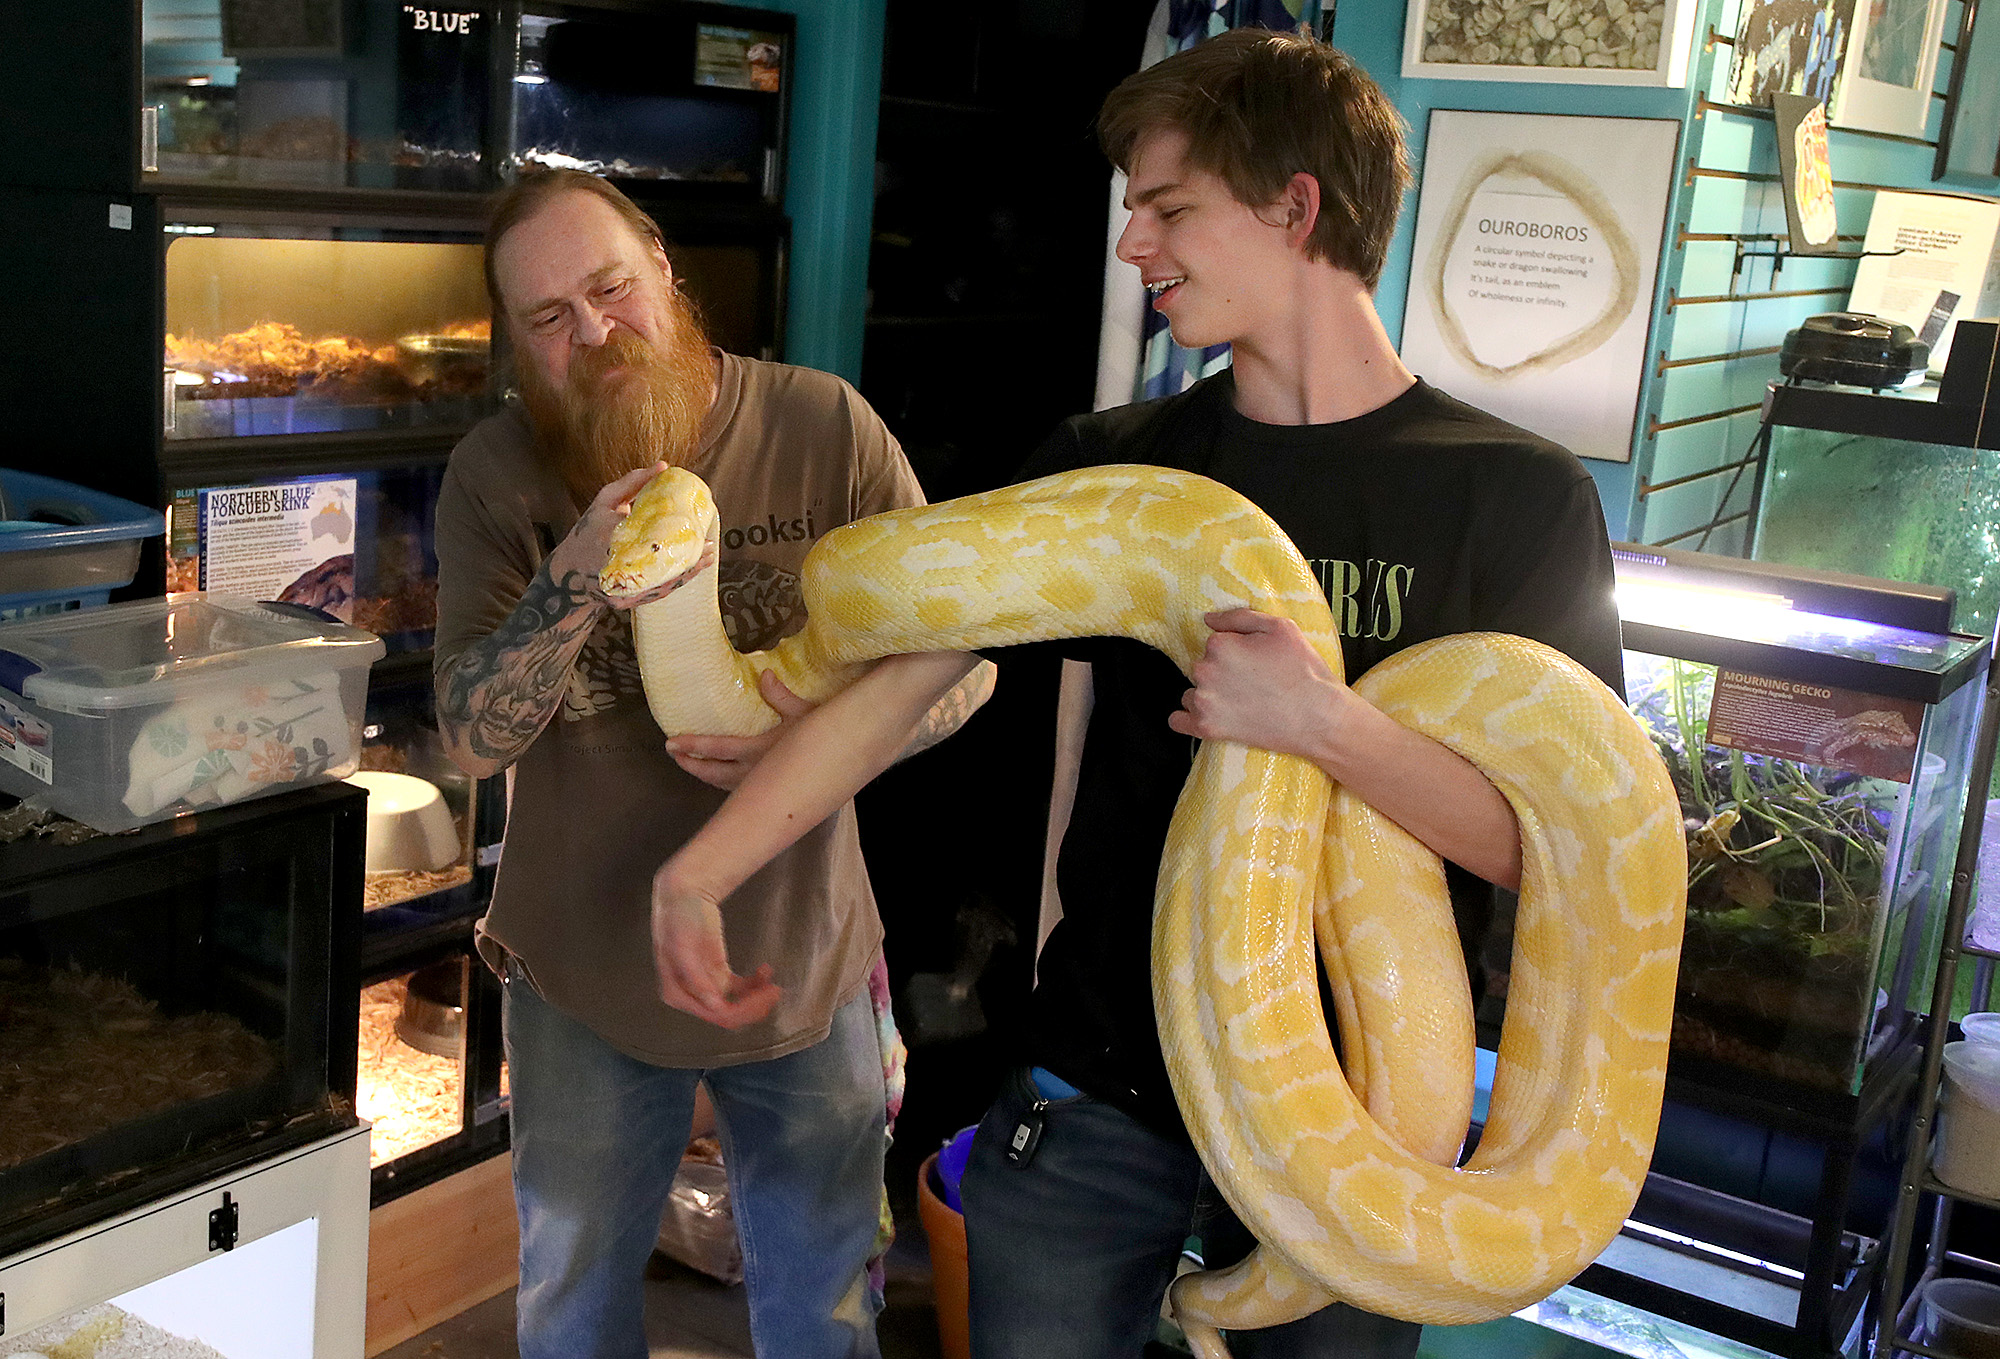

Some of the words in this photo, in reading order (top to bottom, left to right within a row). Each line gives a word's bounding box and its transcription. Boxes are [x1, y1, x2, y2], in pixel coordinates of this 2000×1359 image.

[403, 5, 480, 35] "BLUE"
[1479, 219, 1588, 242] OUROBOROS
[1482, 245, 1513, 255] circular
[1514, 247, 1546, 259] symbol
[1547, 251, 1587, 265] depicting
[1473, 259, 1497, 268] snake
[1498, 261, 1508, 269] or
[1509, 261, 1539, 273] dragon
[1540, 265, 1588, 279] swallowing
[1470, 273, 1483, 282] It's
[1502, 278, 1511, 286] as
[1513, 279, 1524, 287] an
[1525, 280, 1561, 290] emblem
[1468, 289, 1479, 298] Of
[1480, 290, 1523, 303] wholeness
[1524, 296, 1535, 304] or
[211, 500, 270, 518] TONGUED
[274, 494, 310, 513] SKINK
[212, 489, 278, 507] NORTHERN
[281, 486, 315, 501] BLUE-
[1724, 671, 1789, 692] MOURNING
[1792, 684, 1831, 699] GECKO
